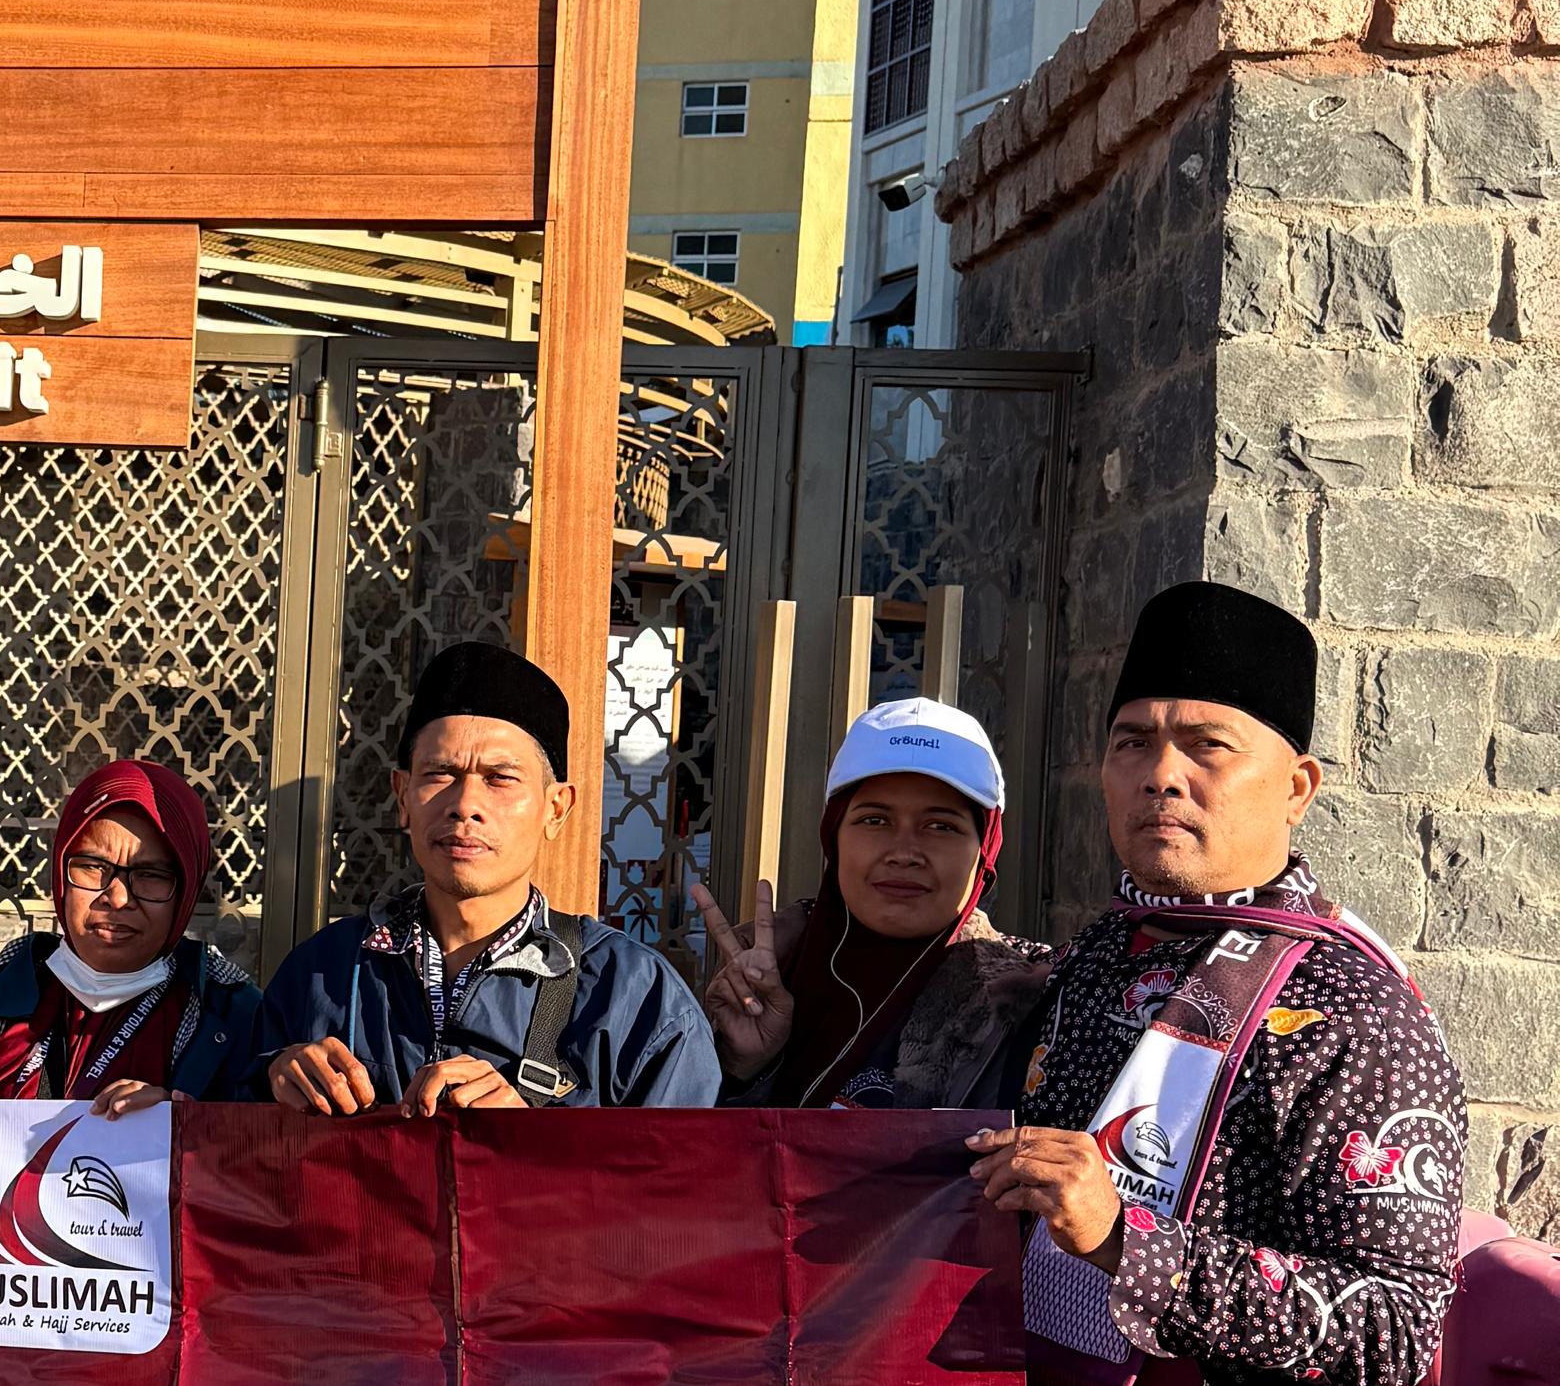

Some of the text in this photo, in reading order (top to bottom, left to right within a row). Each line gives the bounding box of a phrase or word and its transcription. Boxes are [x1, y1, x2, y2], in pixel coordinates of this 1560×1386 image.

[118, 1010, 146, 1041] TOUR
[112, 1036, 125, 1049] &
[86, 1042, 120, 1079] TRAVEL
[70, 1219, 143, 1237] tour & travel
[23, 1315, 34, 1327] &
[40, 1315, 68, 1333] Hajj
[74, 1317, 130, 1333] Services
